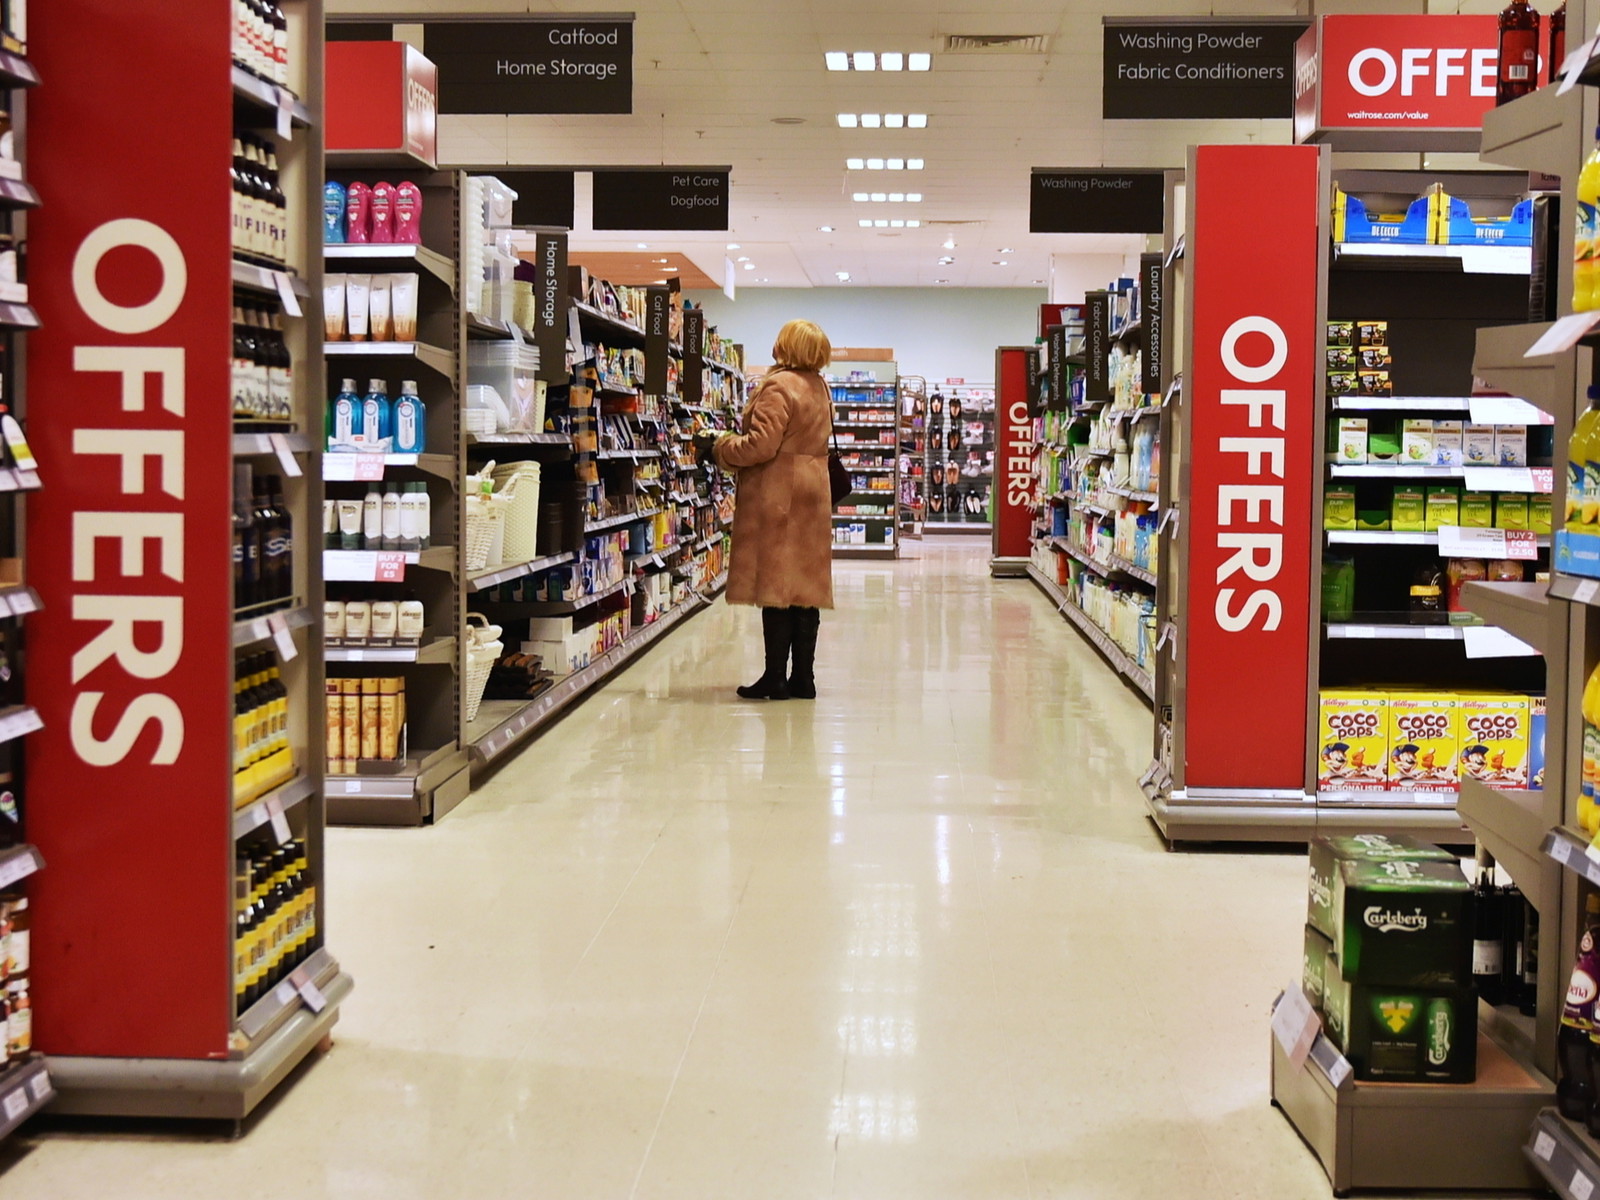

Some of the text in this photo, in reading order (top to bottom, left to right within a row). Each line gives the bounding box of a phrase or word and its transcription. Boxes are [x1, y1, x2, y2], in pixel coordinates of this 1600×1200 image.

[548, 28, 618, 45] Catfood
[1119, 33, 1263, 53] Washing Powder
[496, 59, 618, 80] Home Storage
[1118, 63, 1284, 80] Fabric Conditioners
[1347, 47, 1543, 97] OFFE
[1347, 110, 1429, 120] waitrose.com/value
[672, 175, 720, 187] Pet Care
[1040, 178, 1134, 192] Washing Powder
[670, 194, 720, 210] Dogfood
[542, 240, 558, 327] Home Storage
[653, 295, 663, 336] Cat Food
[1148, 265, 1161, 378] Laundry Accessories
[688, 317, 698, 354] Dog Food
[1093, 301, 1102, 381] Fabric Conditioner
[1052, 332, 1060, 362] Washing
[1007, 401, 1032, 506] OFFERS
[1214, 315, 1288, 632] OFFERS
[70, 217, 188, 767] OFFERS
[1527, 532, 1534, 540] 2
[378, 554, 396, 562] BUY
[1508, 548, 1534, 556] £2.50
[381, 562, 399, 570] FOR
[1328, 712, 1378, 729] COCO
[1397, 714, 1448, 730] COCO
[1467, 715, 1518, 731] COCO
[1337, 726, 1373, 741] pops
[1407, 727, 1443, 742] pops
[1477, 728, 1513, 743] pops
[1363, 905, 1428, 934] Carlsberg
[1428, 1011, 1451, 1065] Carlsberg
